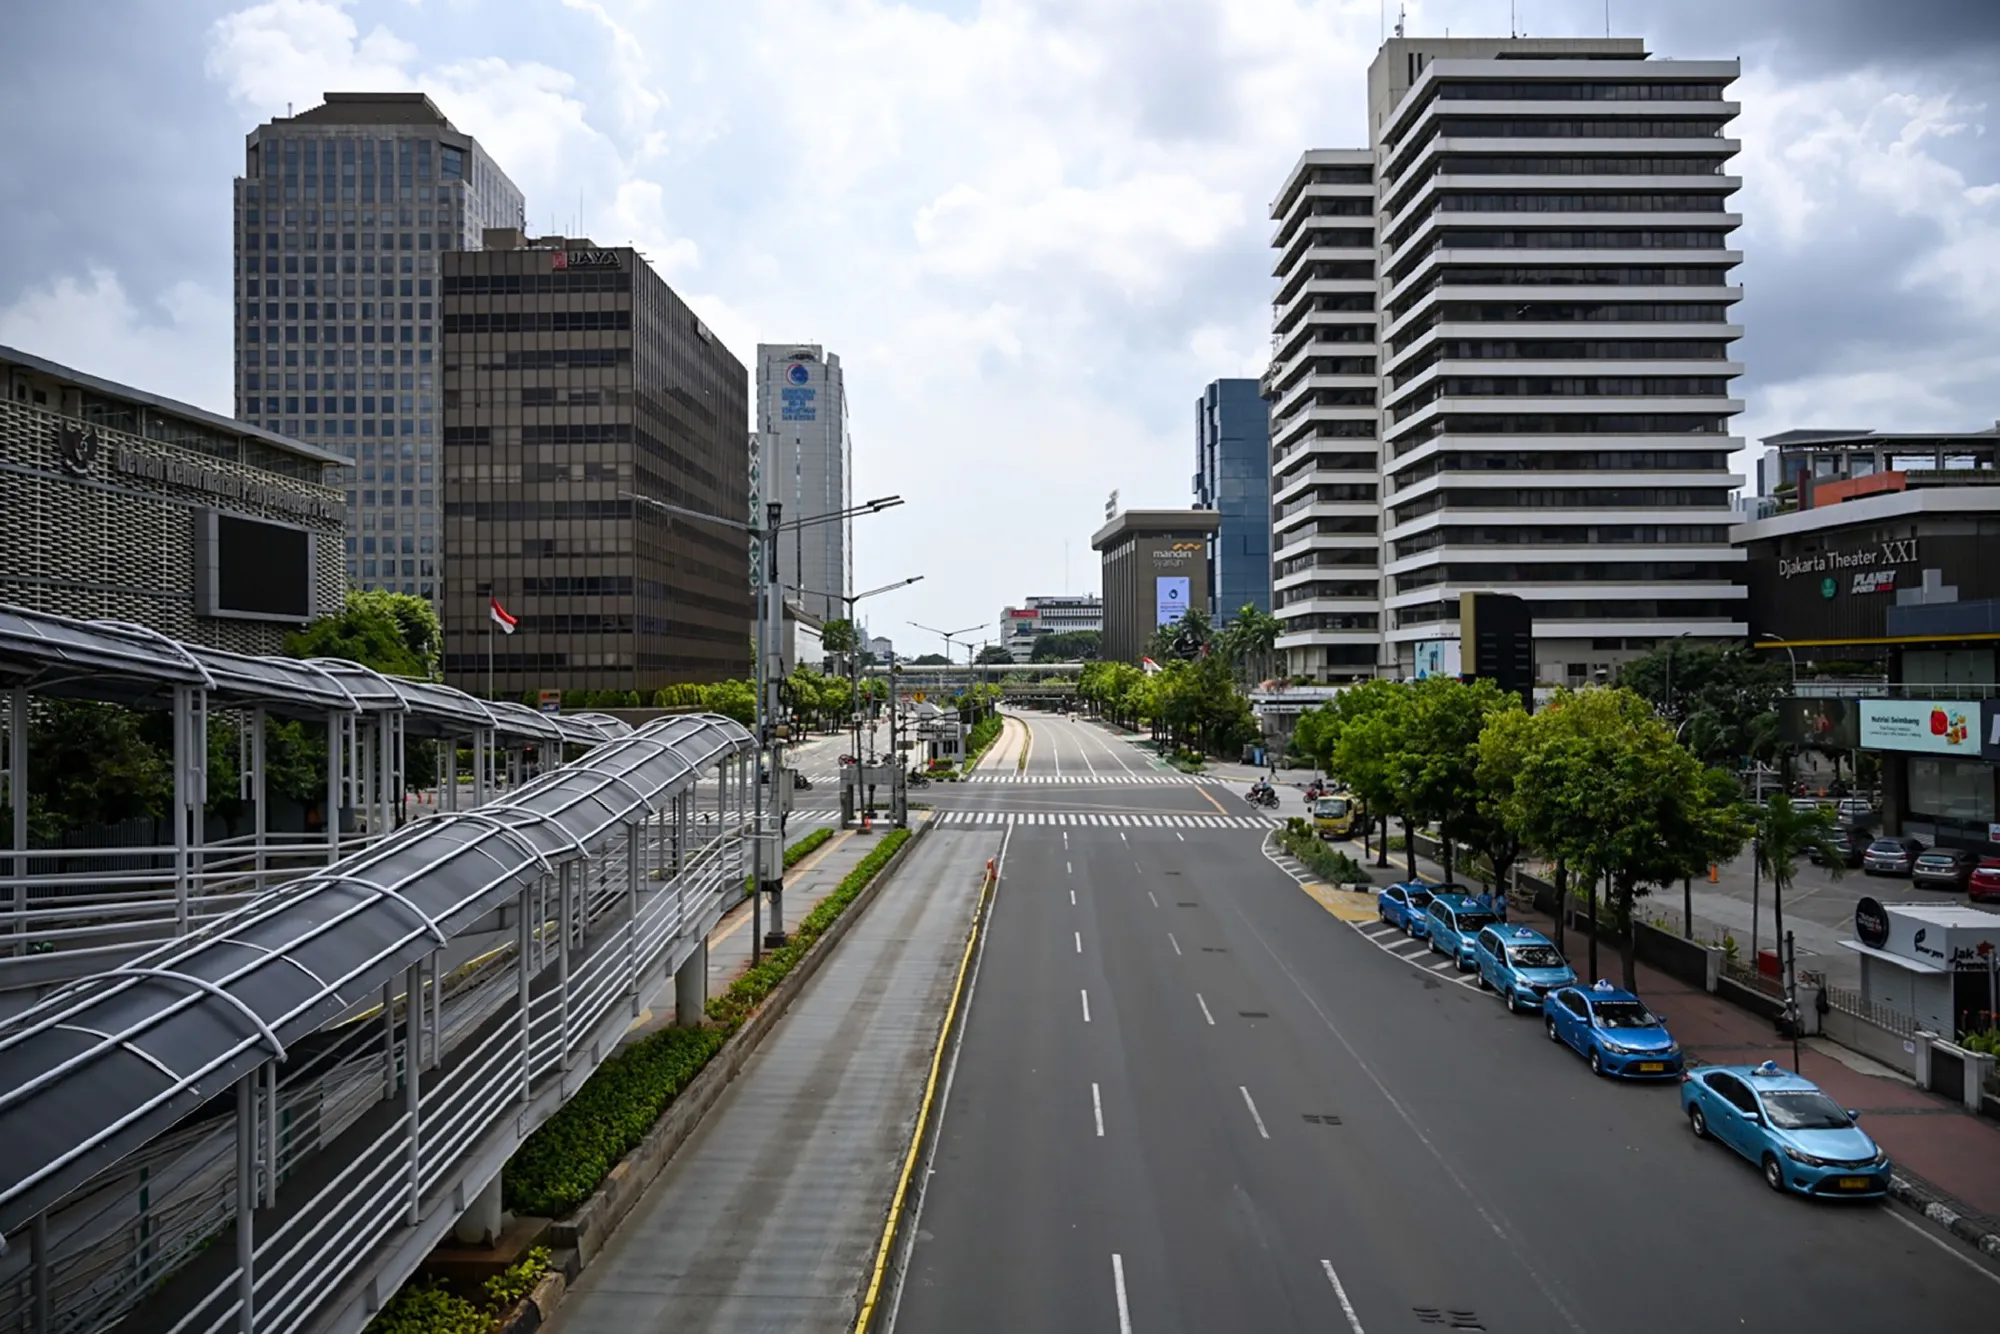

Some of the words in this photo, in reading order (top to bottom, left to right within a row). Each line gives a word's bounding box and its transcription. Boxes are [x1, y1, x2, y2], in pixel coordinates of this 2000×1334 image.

[569, 251, 621, 266] JAYA
[118, 448, 163, 481] Dewan
[1152, 549, 1192, 558] mandiri
[1779, 556, 1826, 579] Djakarta
[1827, 550, 1877, 568] Theater
[1881, 539, 1918, 565] XXI
[1853, 570, 1896, 585] PLANET
[1871, 715, 1890, 724] Nutrisi
[1891, 716, 1920, 727] Seimbang
[1948, 946, 1975, 963] Jak
